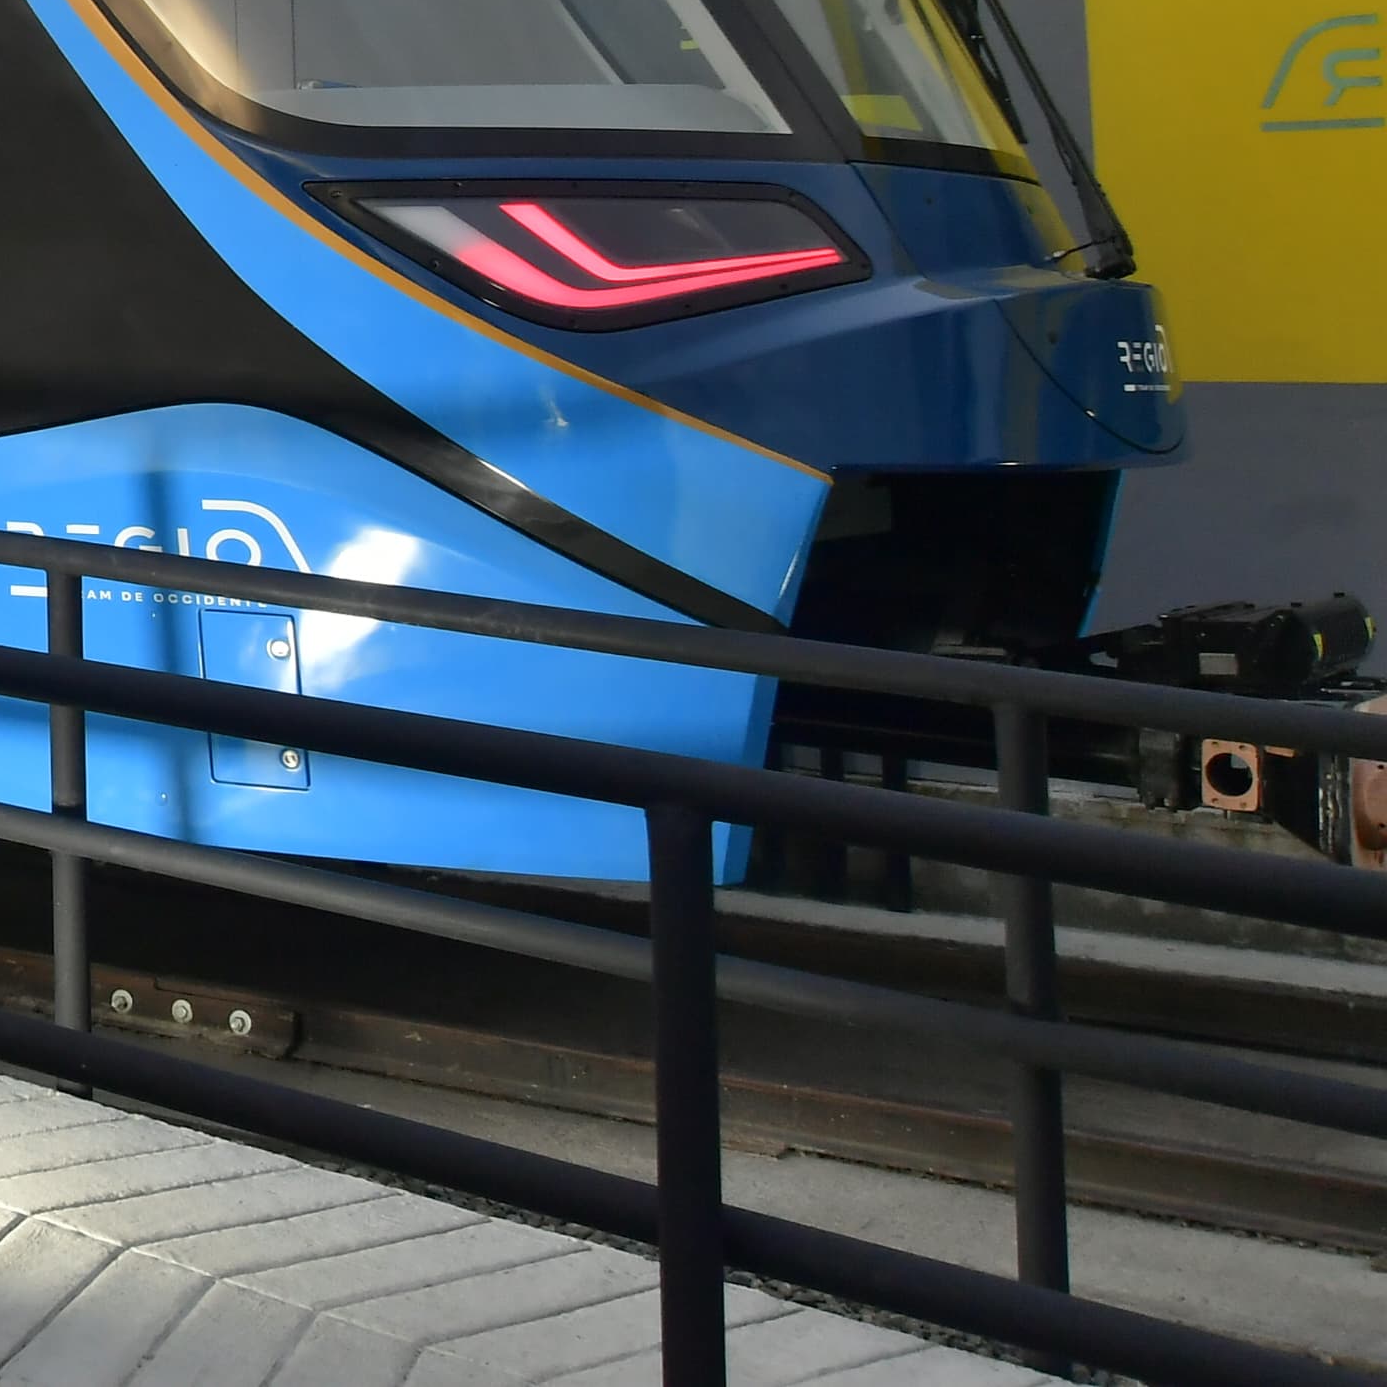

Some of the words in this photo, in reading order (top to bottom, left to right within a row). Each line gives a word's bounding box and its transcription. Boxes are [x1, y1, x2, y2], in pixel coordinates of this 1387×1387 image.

[1117, 341, 1169, 373] REGIO
[82, 589, 112, 600] AM
[121, 591, 144, 602] DE
